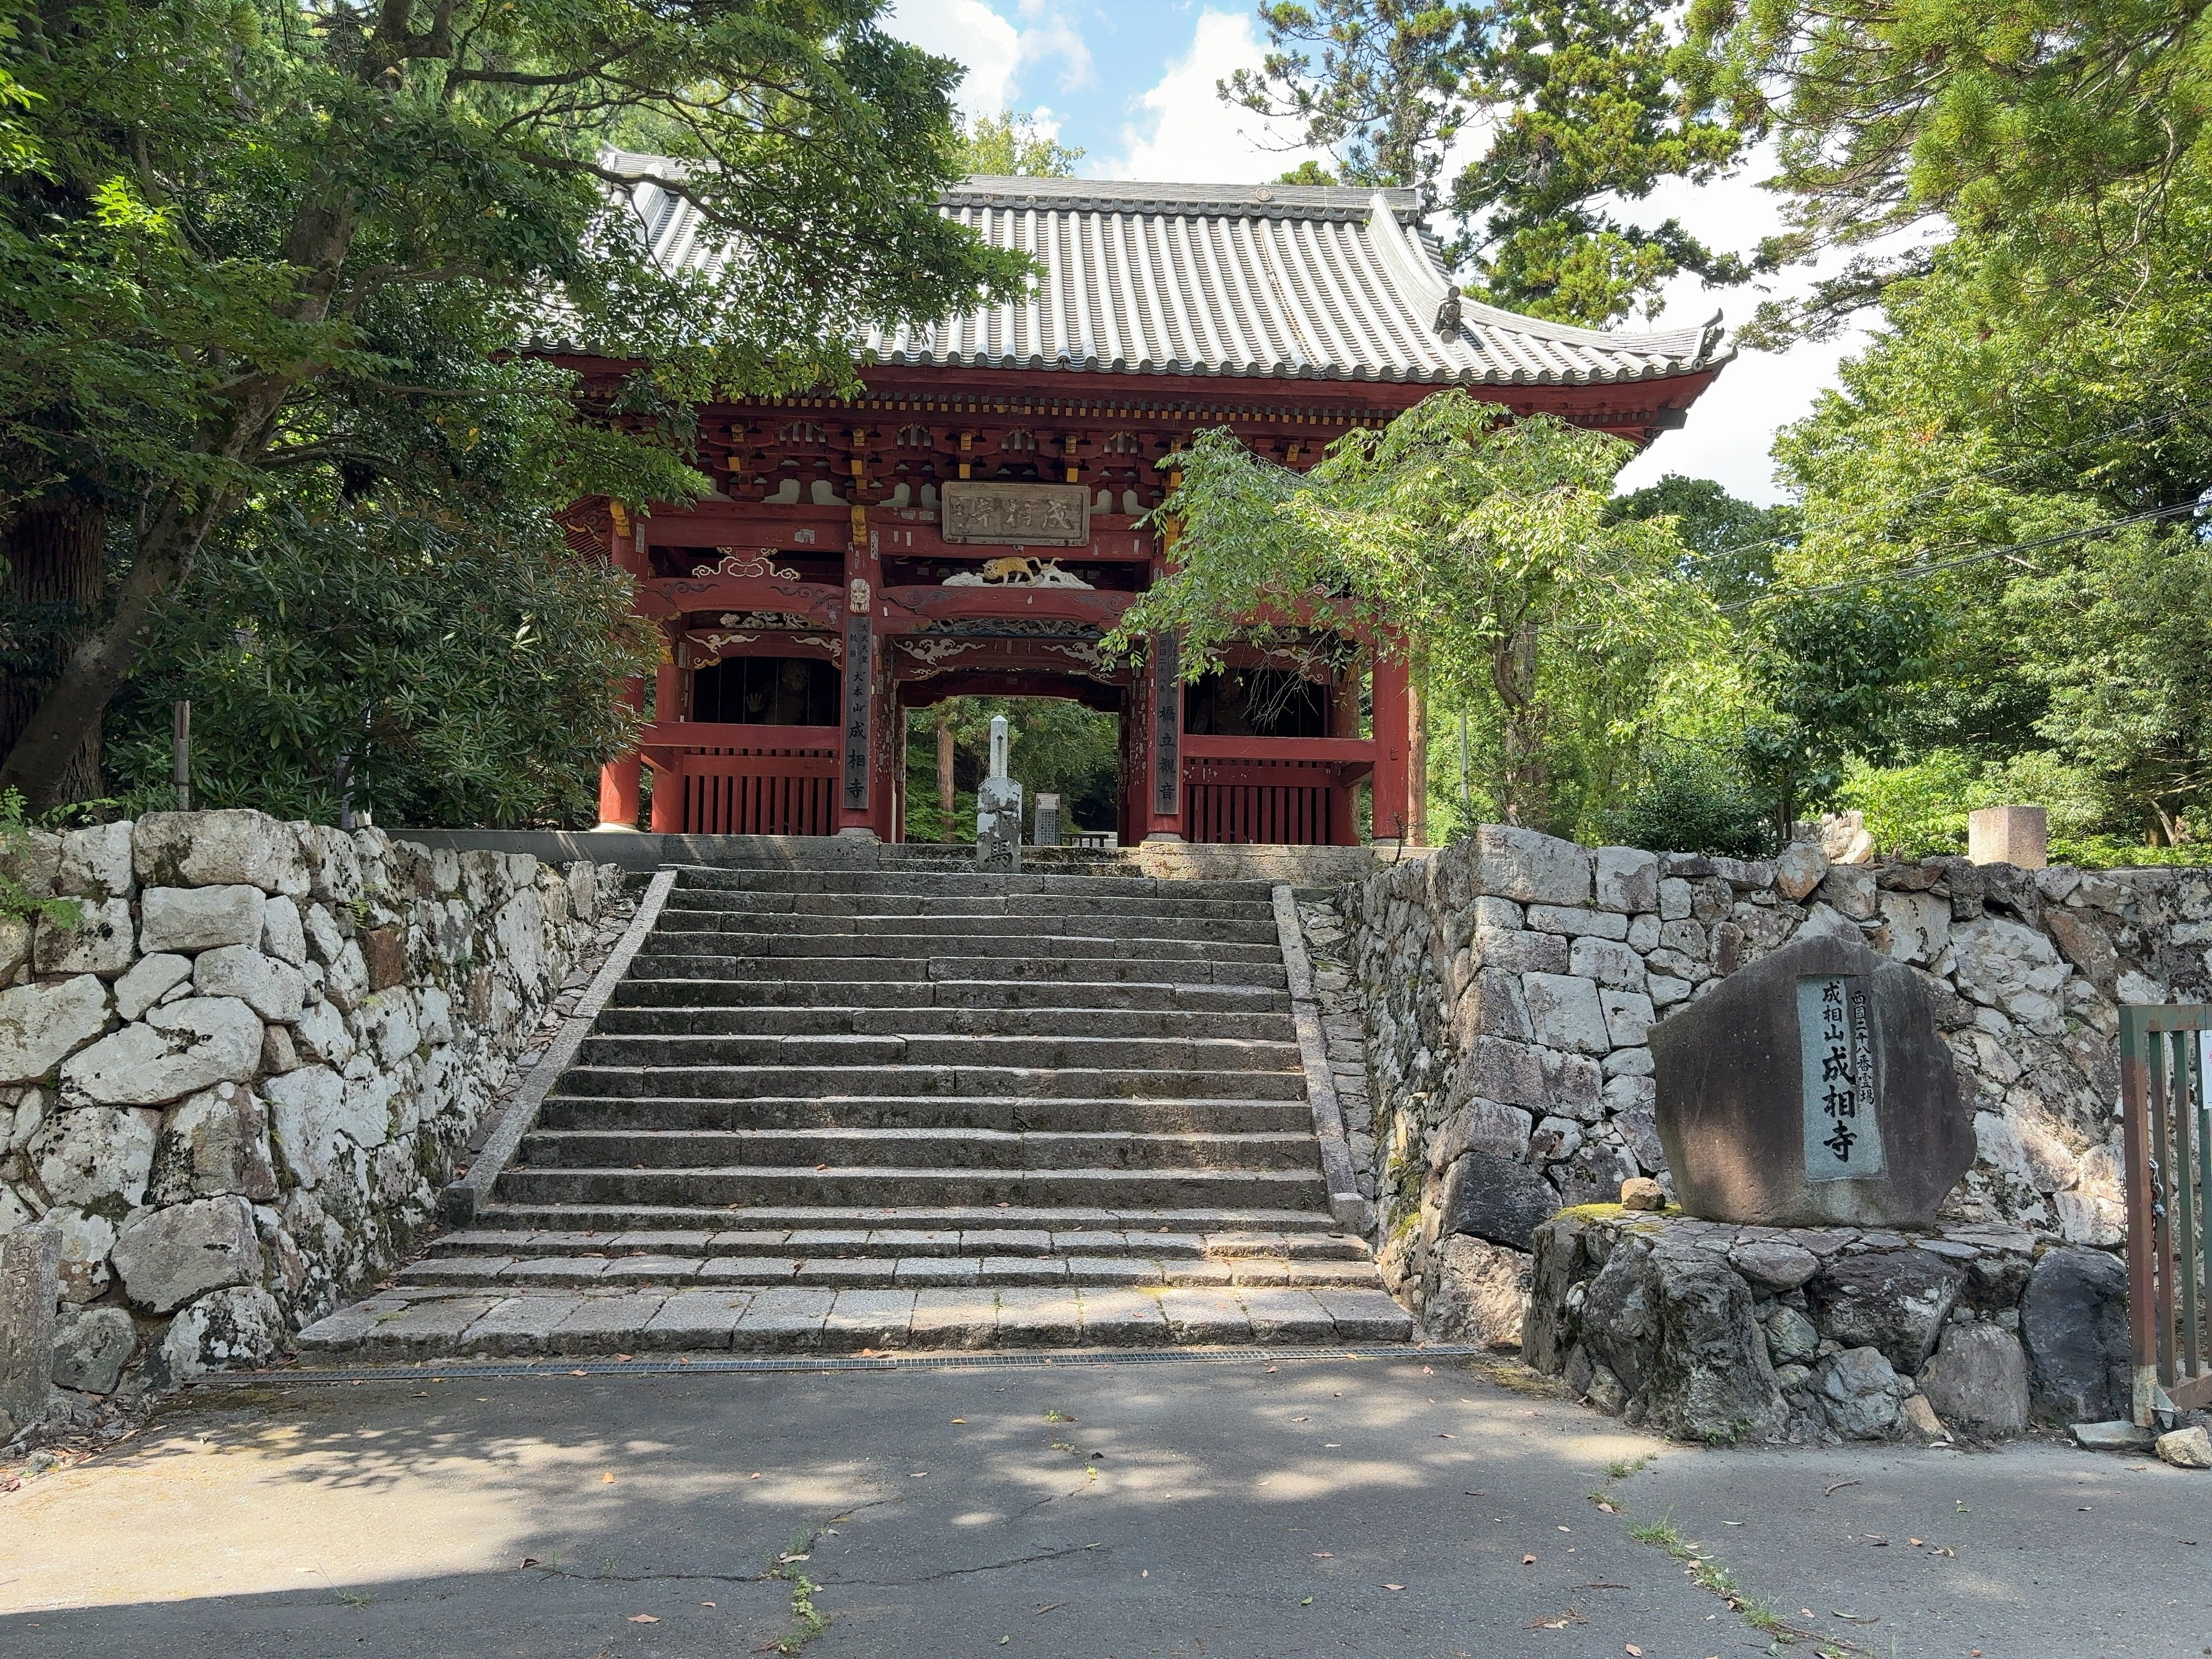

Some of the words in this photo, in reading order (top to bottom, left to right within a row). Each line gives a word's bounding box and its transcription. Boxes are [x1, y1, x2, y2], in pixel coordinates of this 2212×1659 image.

[847, 672, 866, 798] 大本山成相寺
[1159, 706, 1176, 800] 橋立観音
[984, 808, 1014, 869] 下馬
